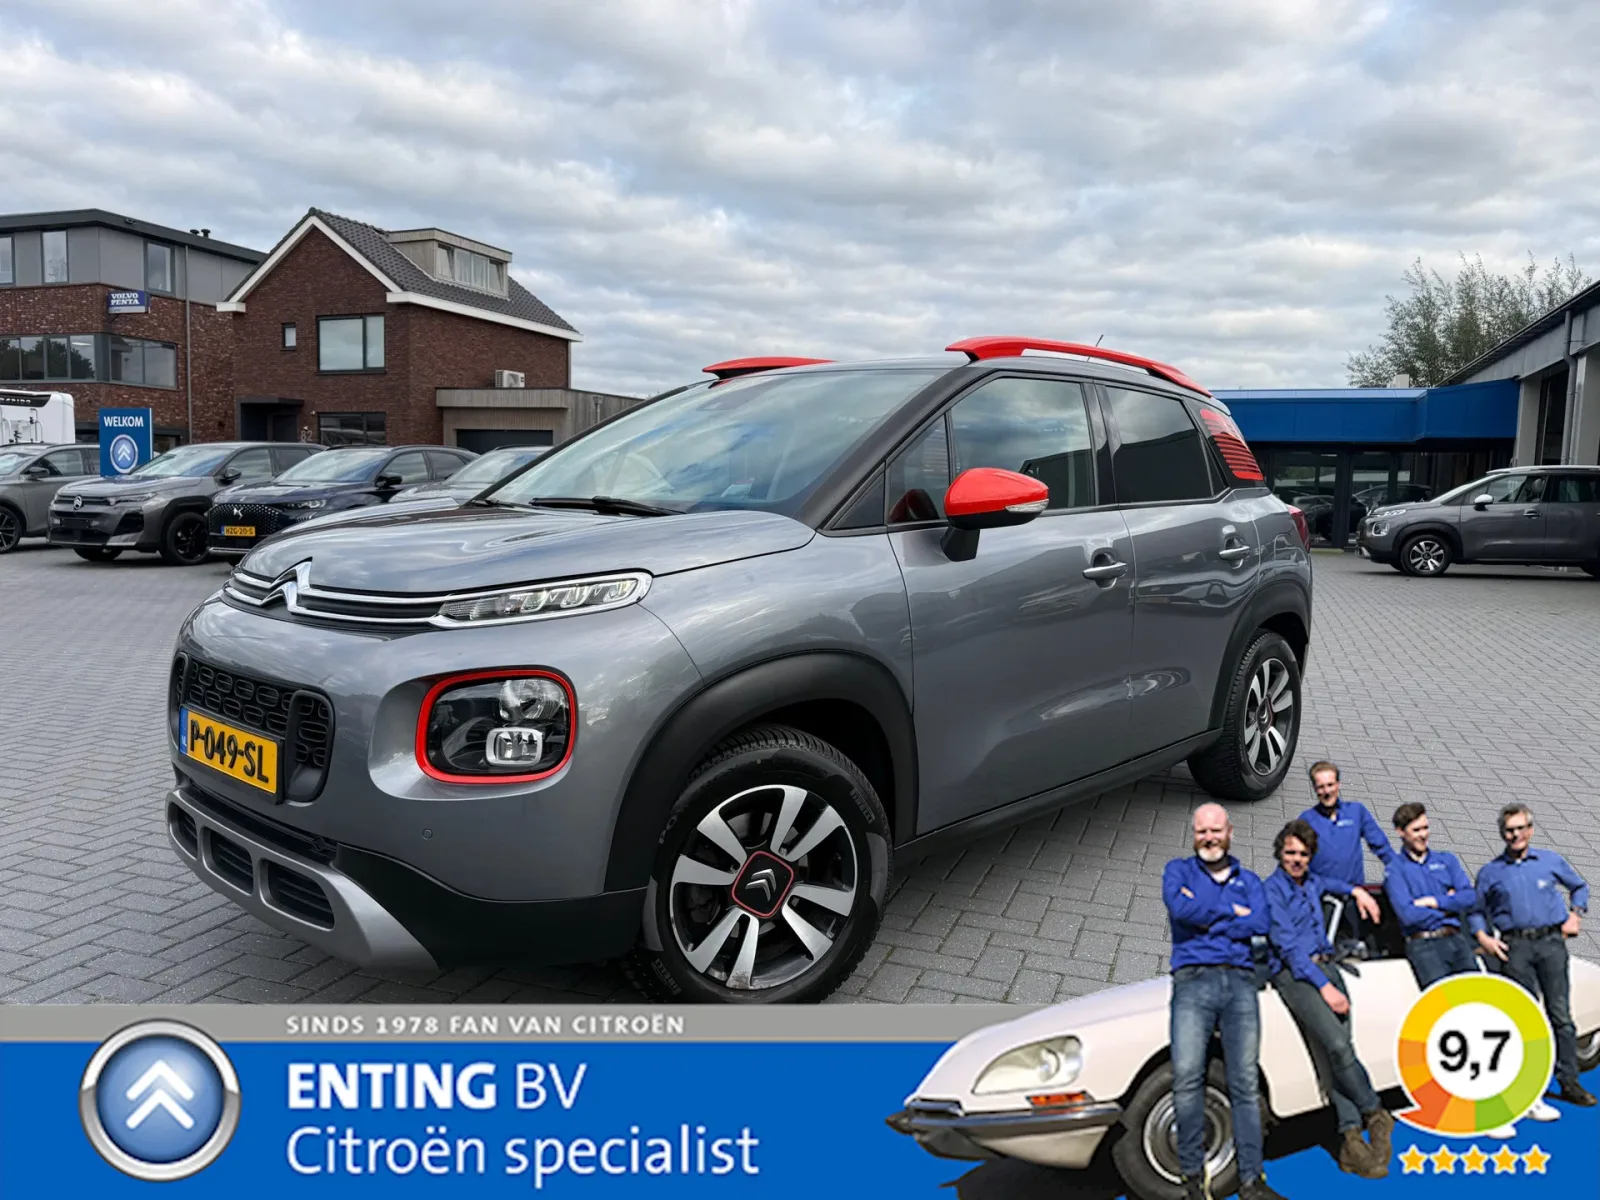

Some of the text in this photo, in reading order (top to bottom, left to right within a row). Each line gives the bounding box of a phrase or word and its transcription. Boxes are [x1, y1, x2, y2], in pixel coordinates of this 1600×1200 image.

[110, 292, 139, 300] VOLVO
[103, 416, 144, 427] WELKOM
[190, 719, 269, 783] P-049-SL
